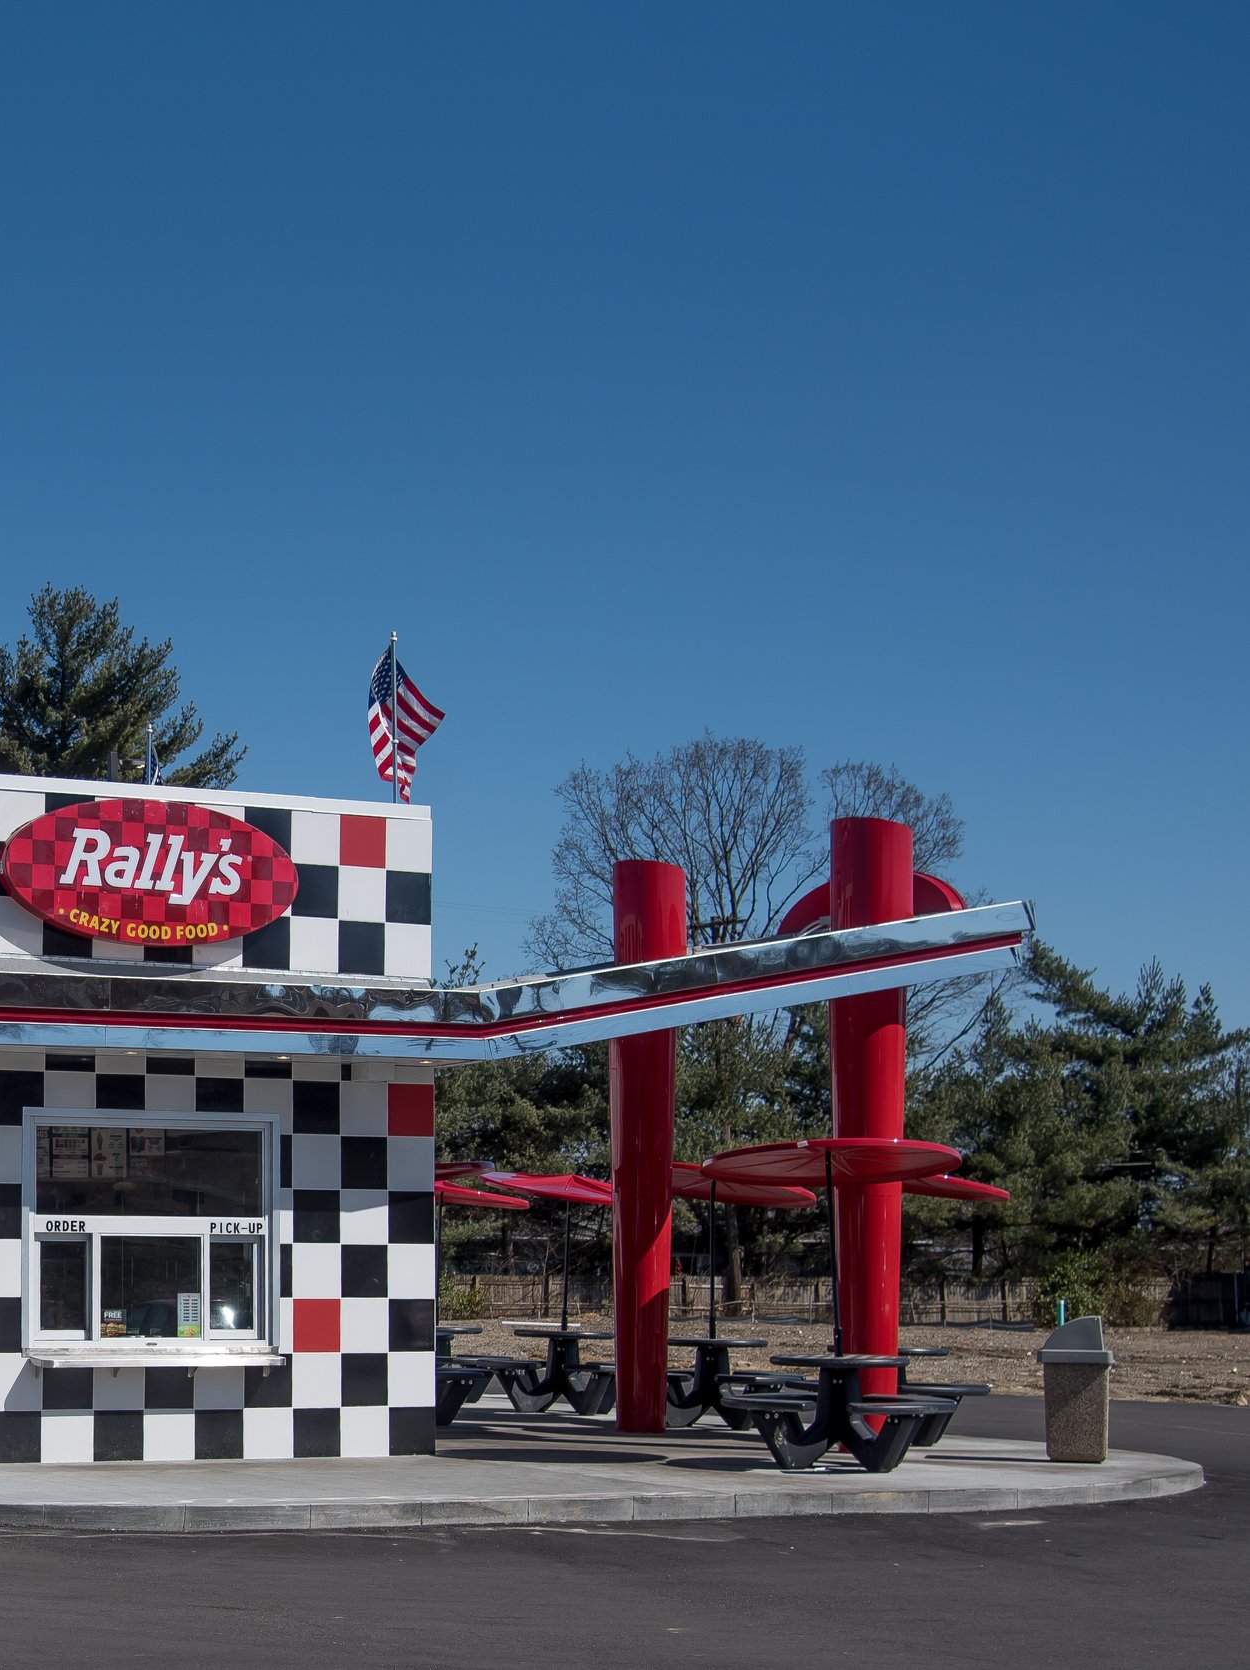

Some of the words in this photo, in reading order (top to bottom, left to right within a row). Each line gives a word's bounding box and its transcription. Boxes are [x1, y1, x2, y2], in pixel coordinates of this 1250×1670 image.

[59, 827, 243, 906] Rally's
[69, 908, 121, 934] CRAZY
[126, 923, 171, 940] GOOD
[176, 923, 218, 939] FOOD
[46, 1220, 86, 1232] ORDER
[210, 1222, 263, 1234] PICK-UP
[104, 1311, 122, 1319] FREE
